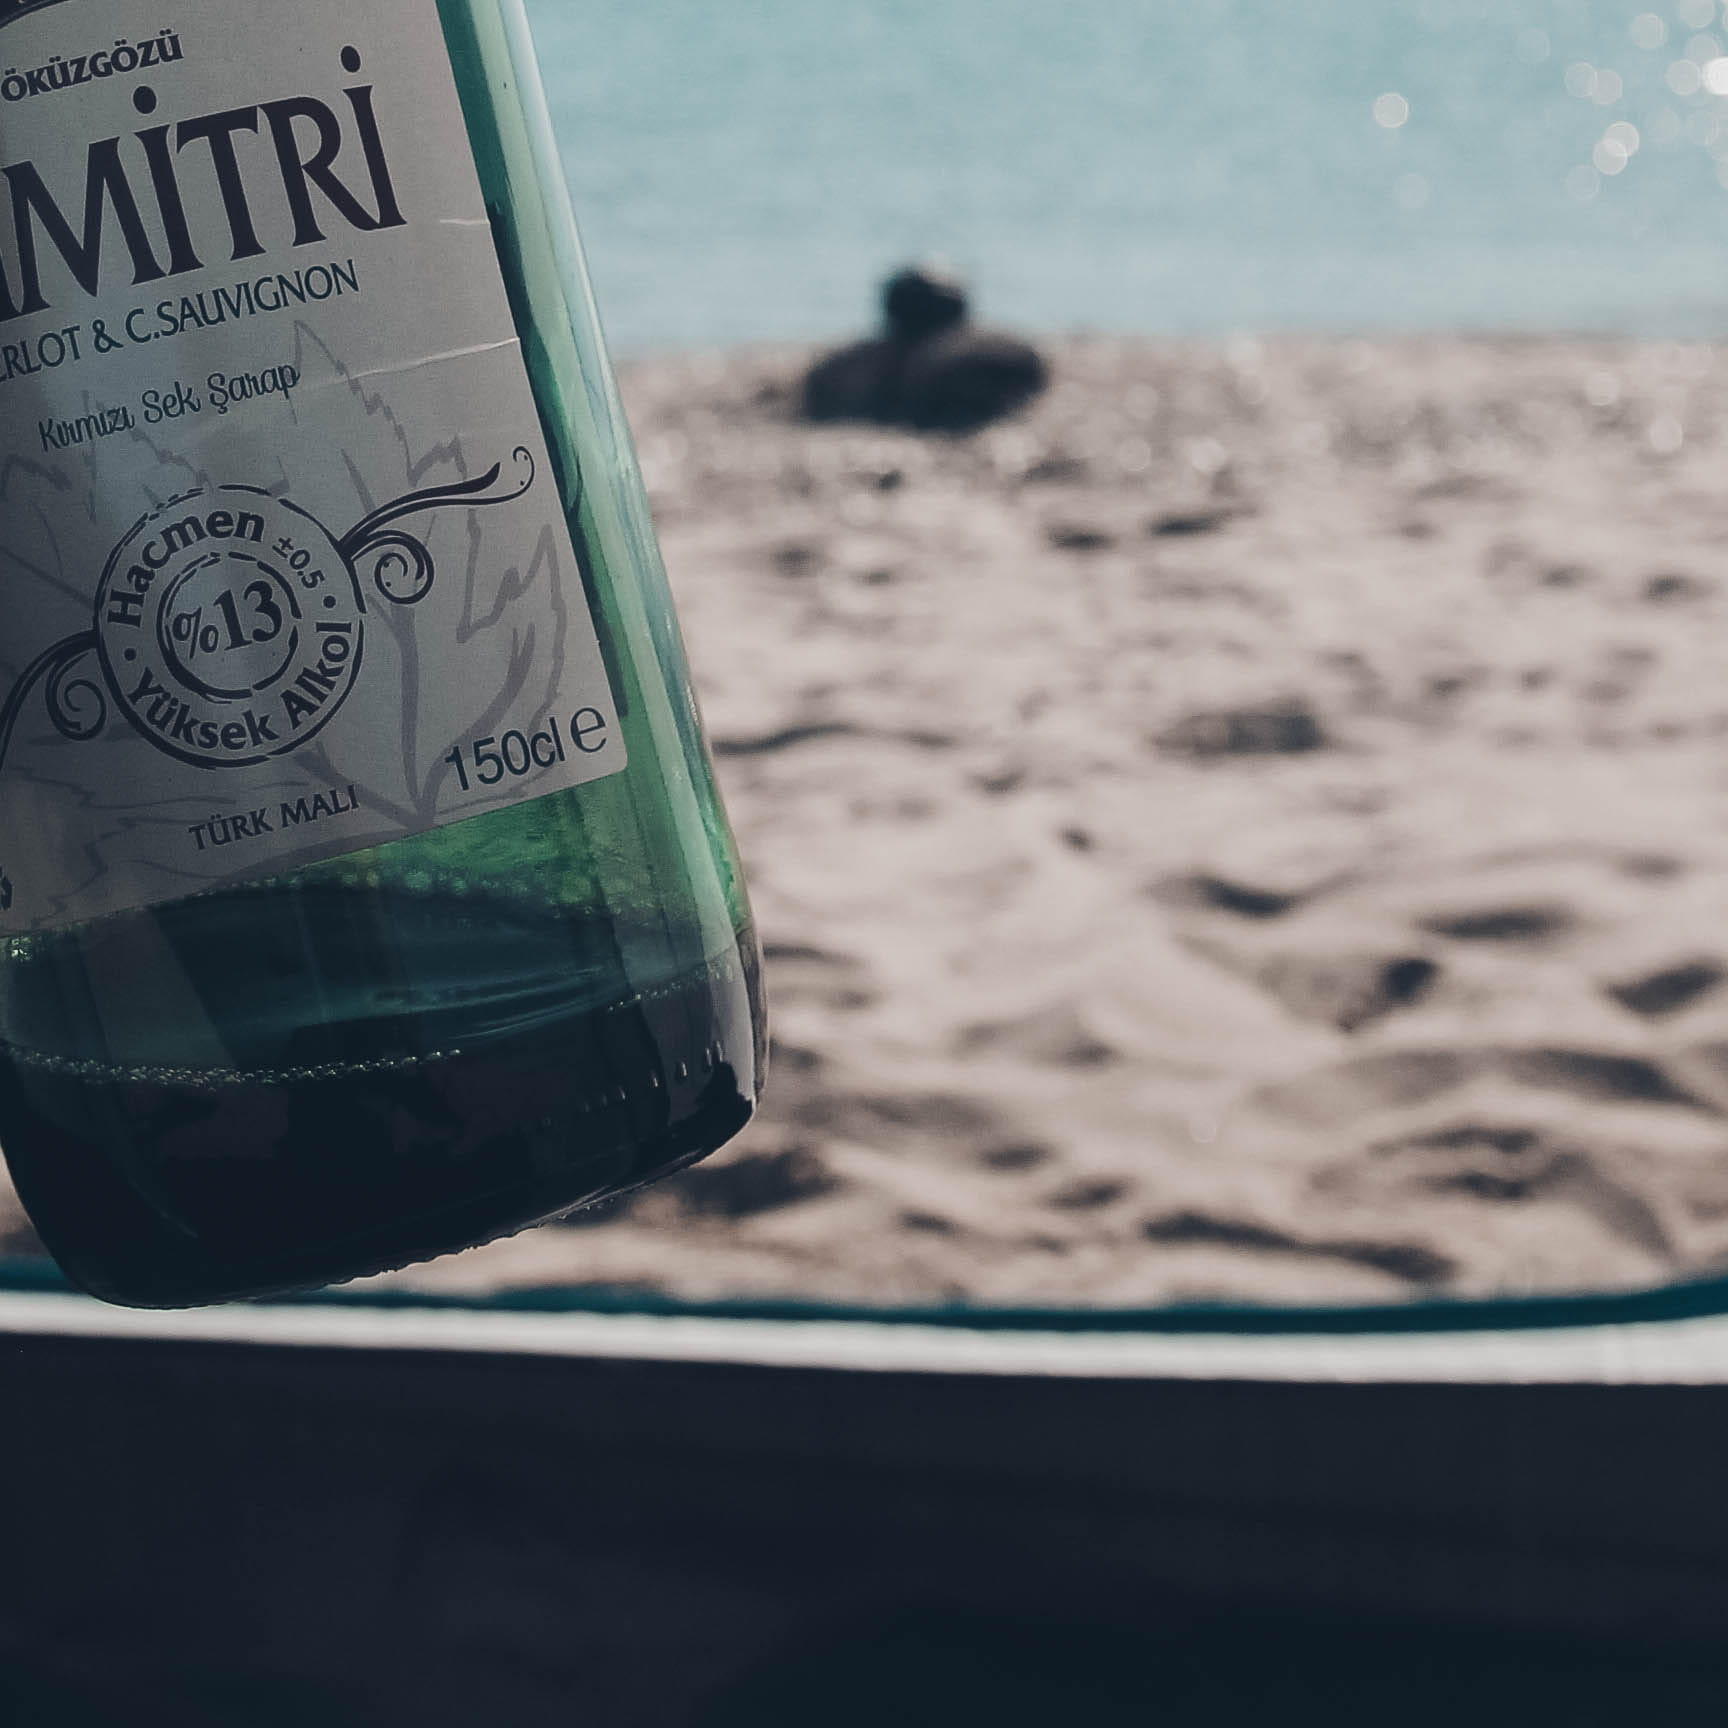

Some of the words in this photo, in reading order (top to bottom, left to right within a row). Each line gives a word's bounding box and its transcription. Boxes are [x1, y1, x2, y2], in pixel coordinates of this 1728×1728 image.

[0, 28, 185, 102] ÖKÜZGÖZÜ
[93, 318, 123, 354] &
[124, 258, 360, 344] C.SAUVIGNON
[38, 407, 135, 453] Kırmızı
[141, 381, 202, 424] Sek
[207, 363, 301, 415] Şarap
[107, 509, 266, 628] Hacmen
[271, 535, 325, 589] ±0.5
[171, 579, 283, 659] %13
[127, 666, 280, 751] Yüksek
[280, 620, 352, 730] Alkol
[444, 717, 566, 792] 150cl
[187, 806, 274, 851] TÜRK
[279, 784, 360, 828] MALI
